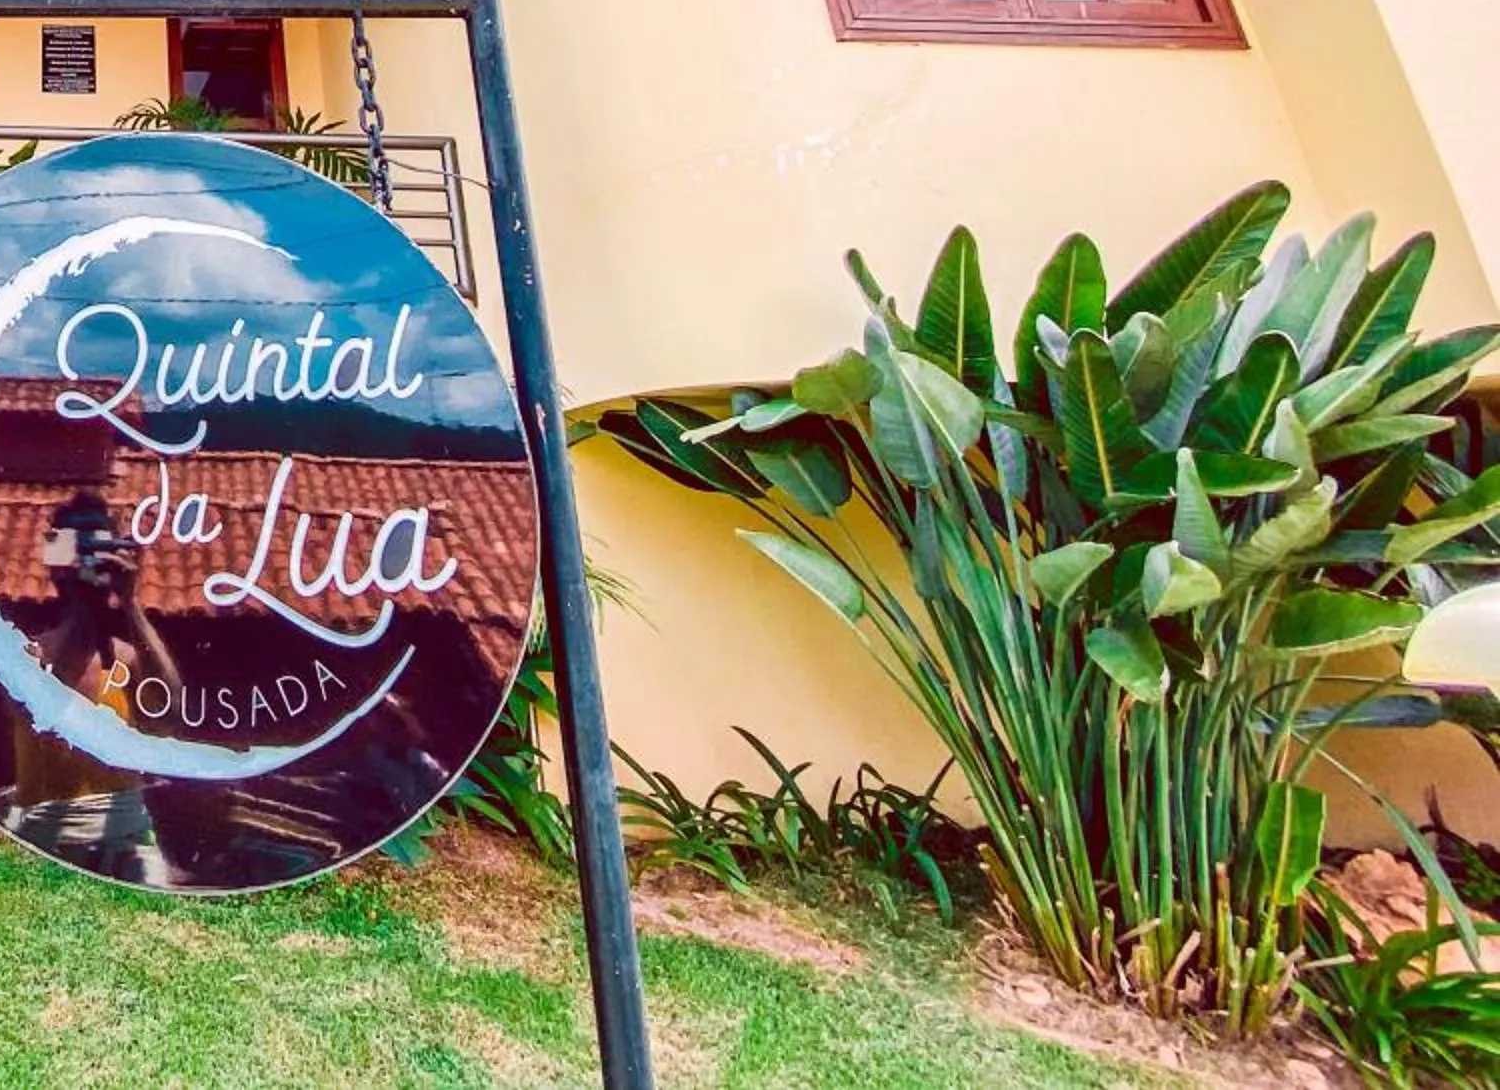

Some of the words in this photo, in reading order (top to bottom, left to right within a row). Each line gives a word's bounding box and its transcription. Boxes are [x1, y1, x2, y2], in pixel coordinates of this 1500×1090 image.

[56, 304, 424, 454] Quintal
[132, 462, 222, 545] da
[204, 457, 457, 648] Lua
[102, 660, 347, 729] POUSADA
